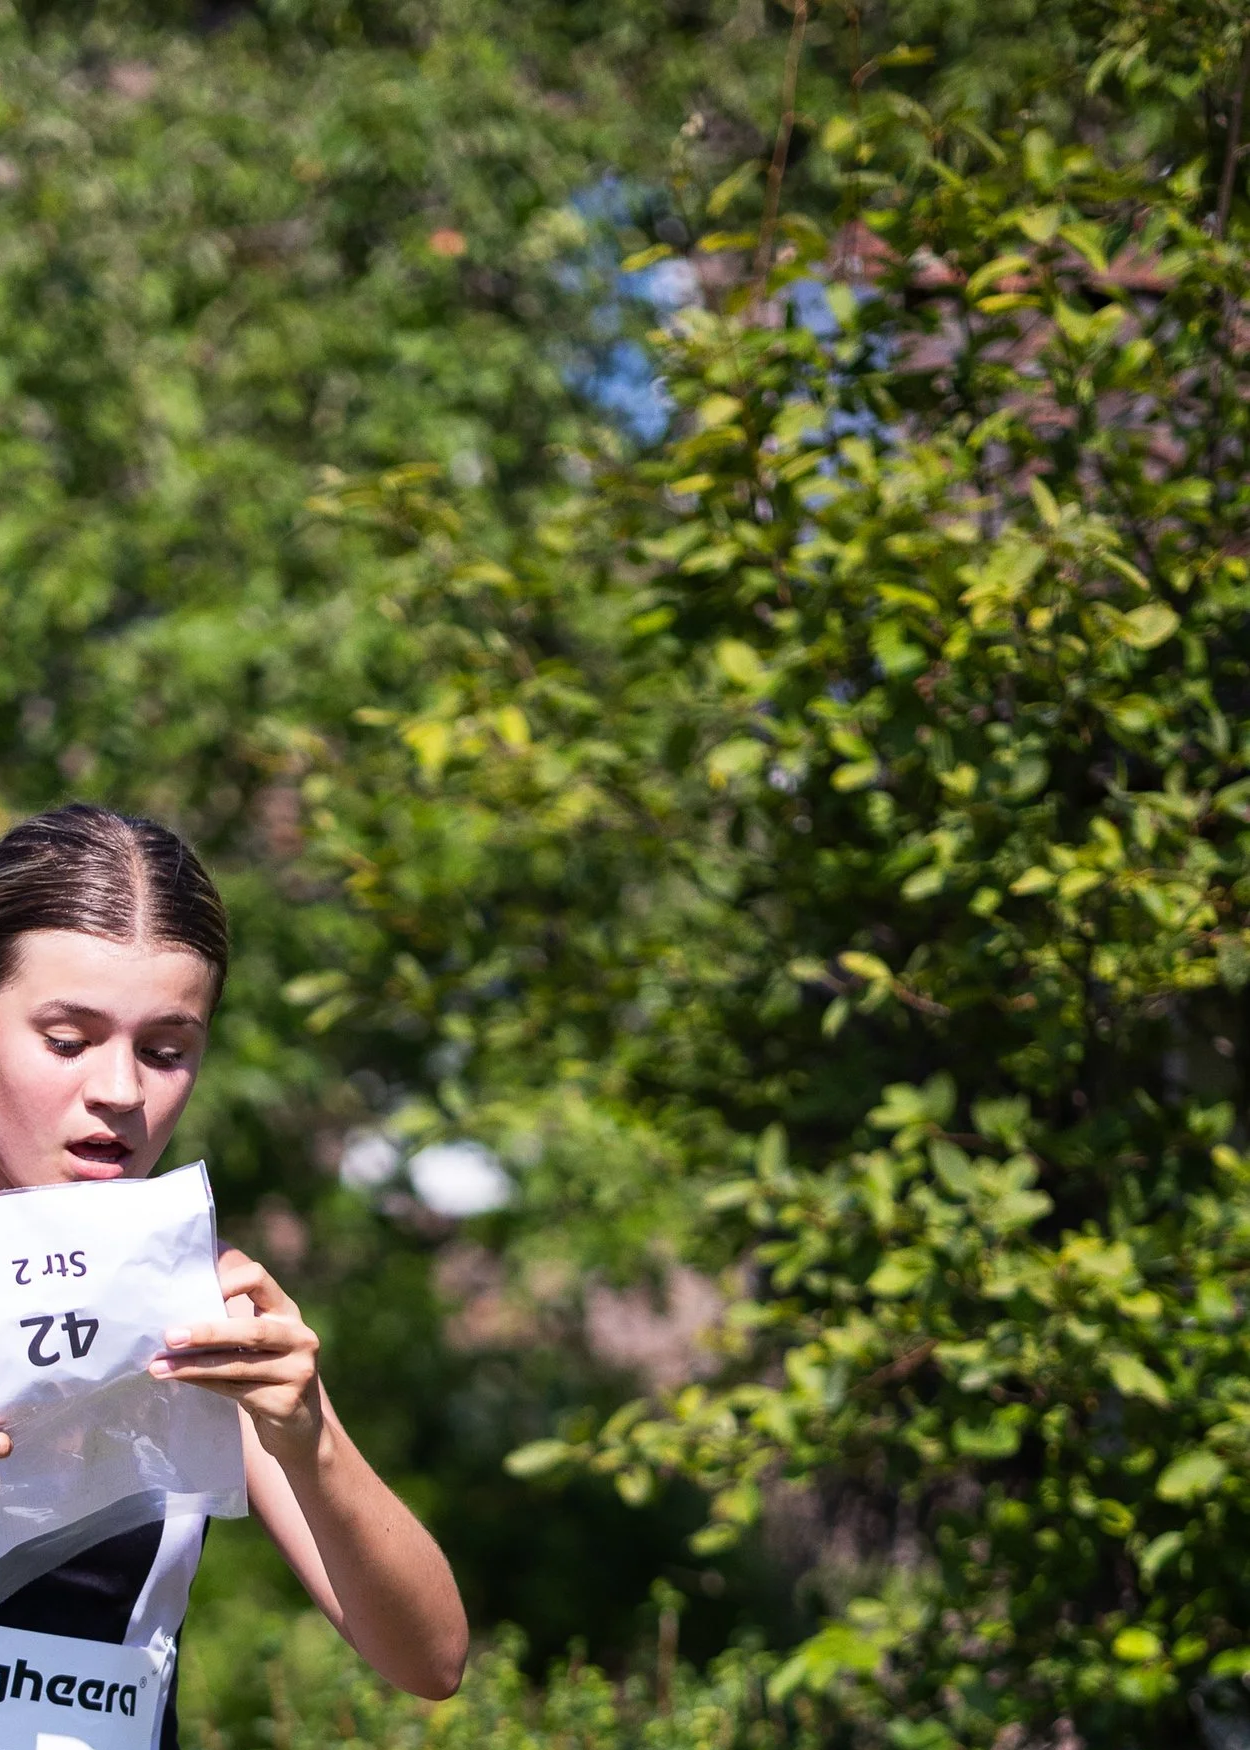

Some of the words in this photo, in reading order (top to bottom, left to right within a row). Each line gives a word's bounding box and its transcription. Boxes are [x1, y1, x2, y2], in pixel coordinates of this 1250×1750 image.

[11, 1258, 32, 1286] 2
[42, 1250, 87, 1278] Str
[19, 1311, 100, 1367] 42
